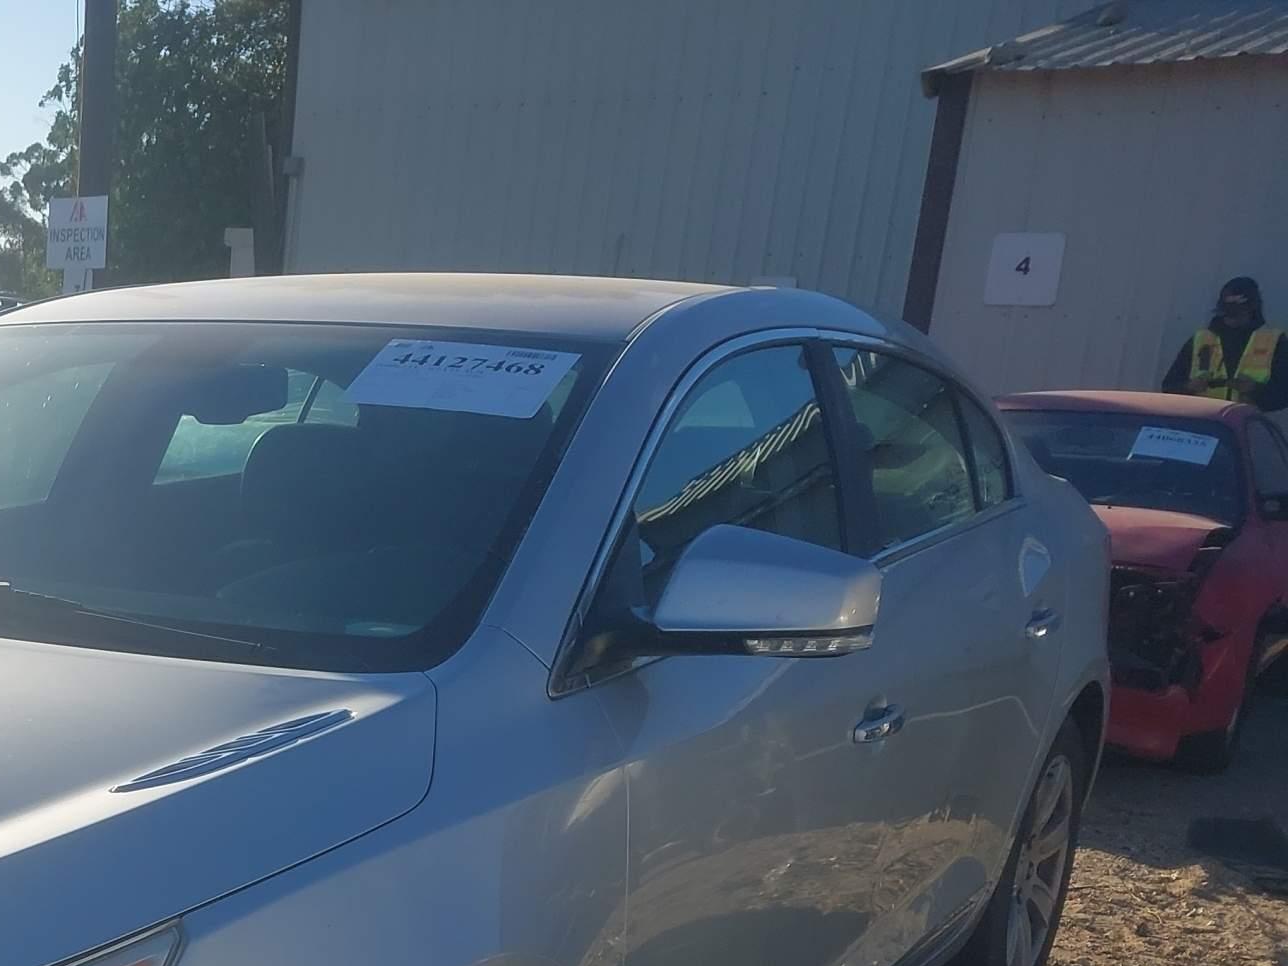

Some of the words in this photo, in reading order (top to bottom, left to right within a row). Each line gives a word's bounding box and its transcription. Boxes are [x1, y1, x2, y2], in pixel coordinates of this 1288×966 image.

[51, 228, 104, 242] INSPECTION
[65, 246, 92, 261] AREA
[1015, 256, 1031, 275] 4
[393, 353, 545, 376] 44127468
